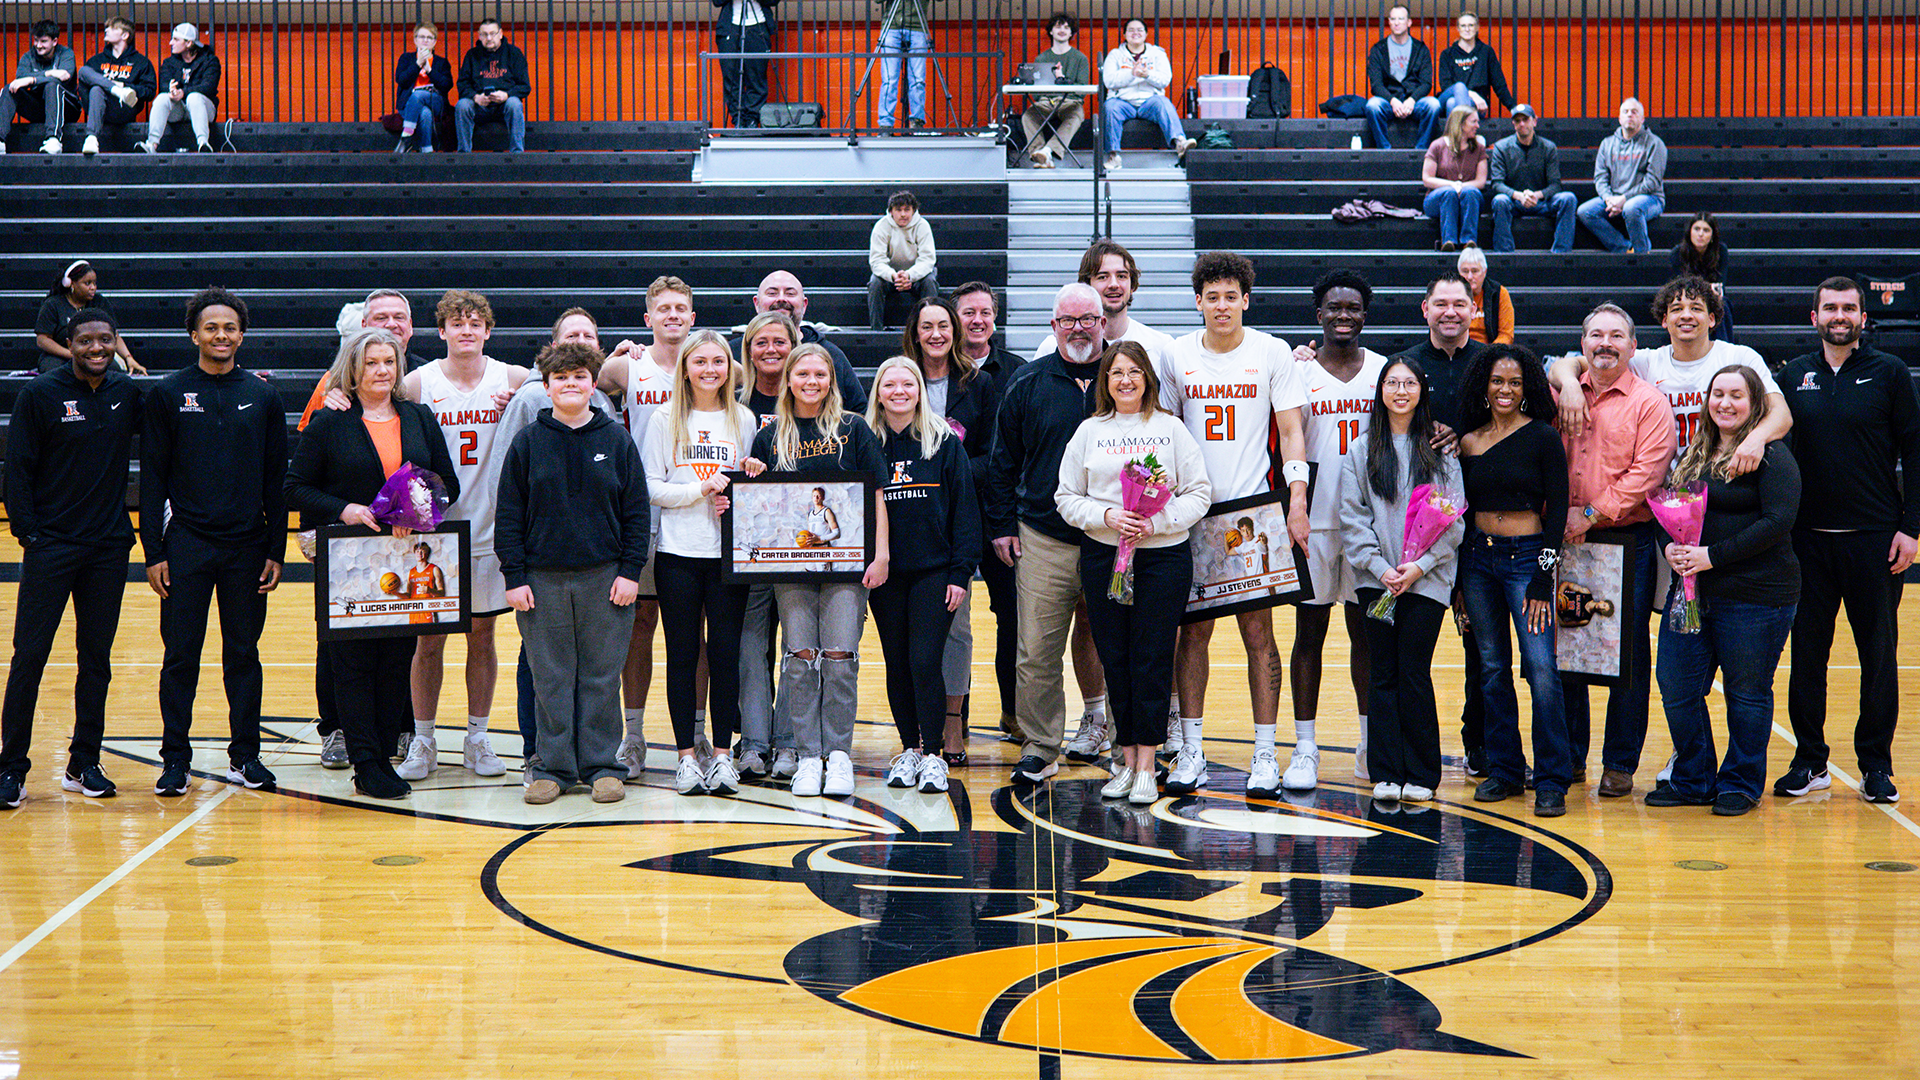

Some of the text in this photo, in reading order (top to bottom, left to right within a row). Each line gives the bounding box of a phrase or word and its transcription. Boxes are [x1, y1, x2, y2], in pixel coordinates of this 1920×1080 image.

[1870, 282, 1905, 291] STURGIS
[636, 390, 672, 405] KALA
[1184, 384, 1258, 399] KALAMAZOO
[1663, 391, 1708, 408] LAMA
[61, 415, 86, 423] BASKETBALL
[433, 409, 500, 427] ALAMAZO
[1204, 405, 1236, 441] 21
[1097, 436, 1171, 448] KALAMAZOO
[1337, 419, 1360, 455] 11
[460, 430, 478, 466] 2
[682, 445, 728, 461] HORNETS
[1106, 444, 1159, 455] COLLEGE
[883, 489, 928, 501] ASKETBALL
[761, 551, 790, 559] CARTER
[790, 551, 831, 559] BANDEMER
[1245, 556, 1253, 568] 21
[1216, 586, 1228, 595] JJ
[1228, 578, 1262, 592] STEVENS
[360, 604, 387, 613] LUCAS
[388, 602, 424, 611] HANIFAN
